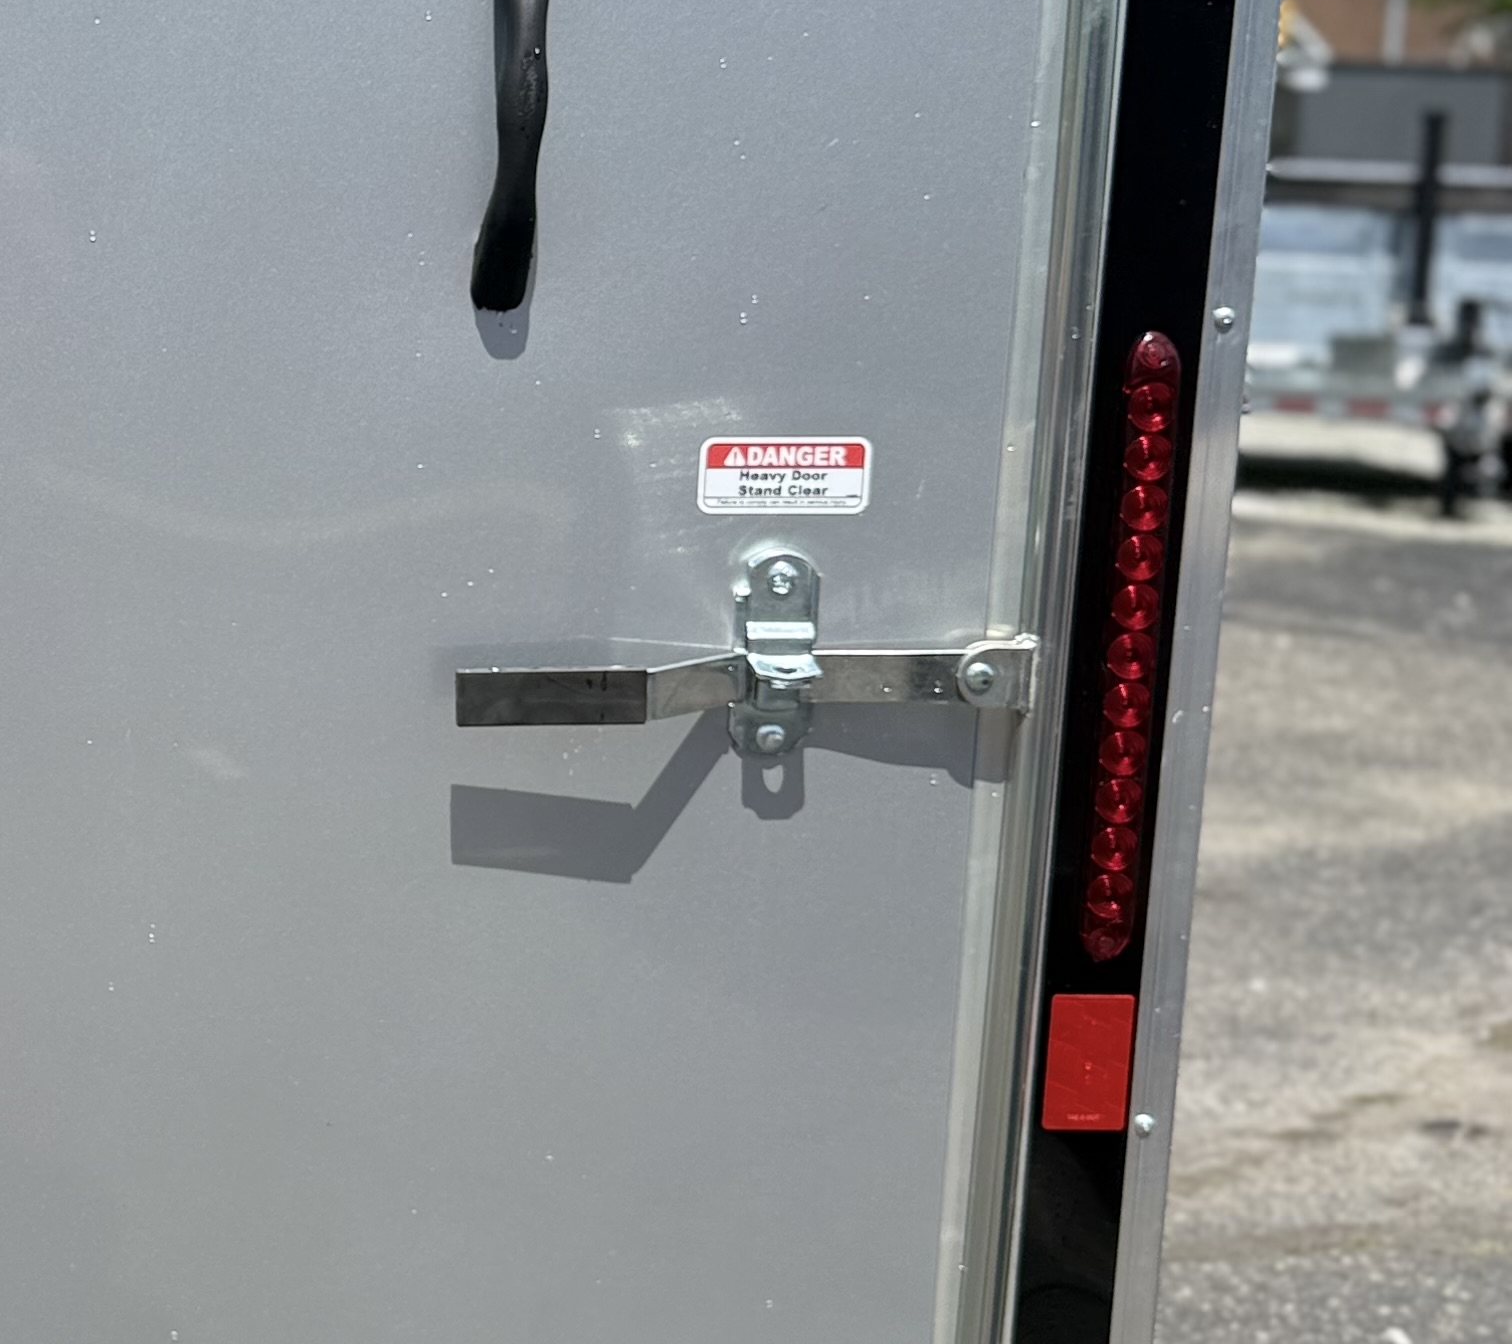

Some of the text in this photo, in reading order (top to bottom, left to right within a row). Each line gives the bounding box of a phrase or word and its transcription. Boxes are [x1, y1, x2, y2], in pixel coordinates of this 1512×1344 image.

[746, 445, 847, 467] DANGER
[739, 470, 828, 483] Heavy Door
[738, 485, 828, 496] Stand Clear
